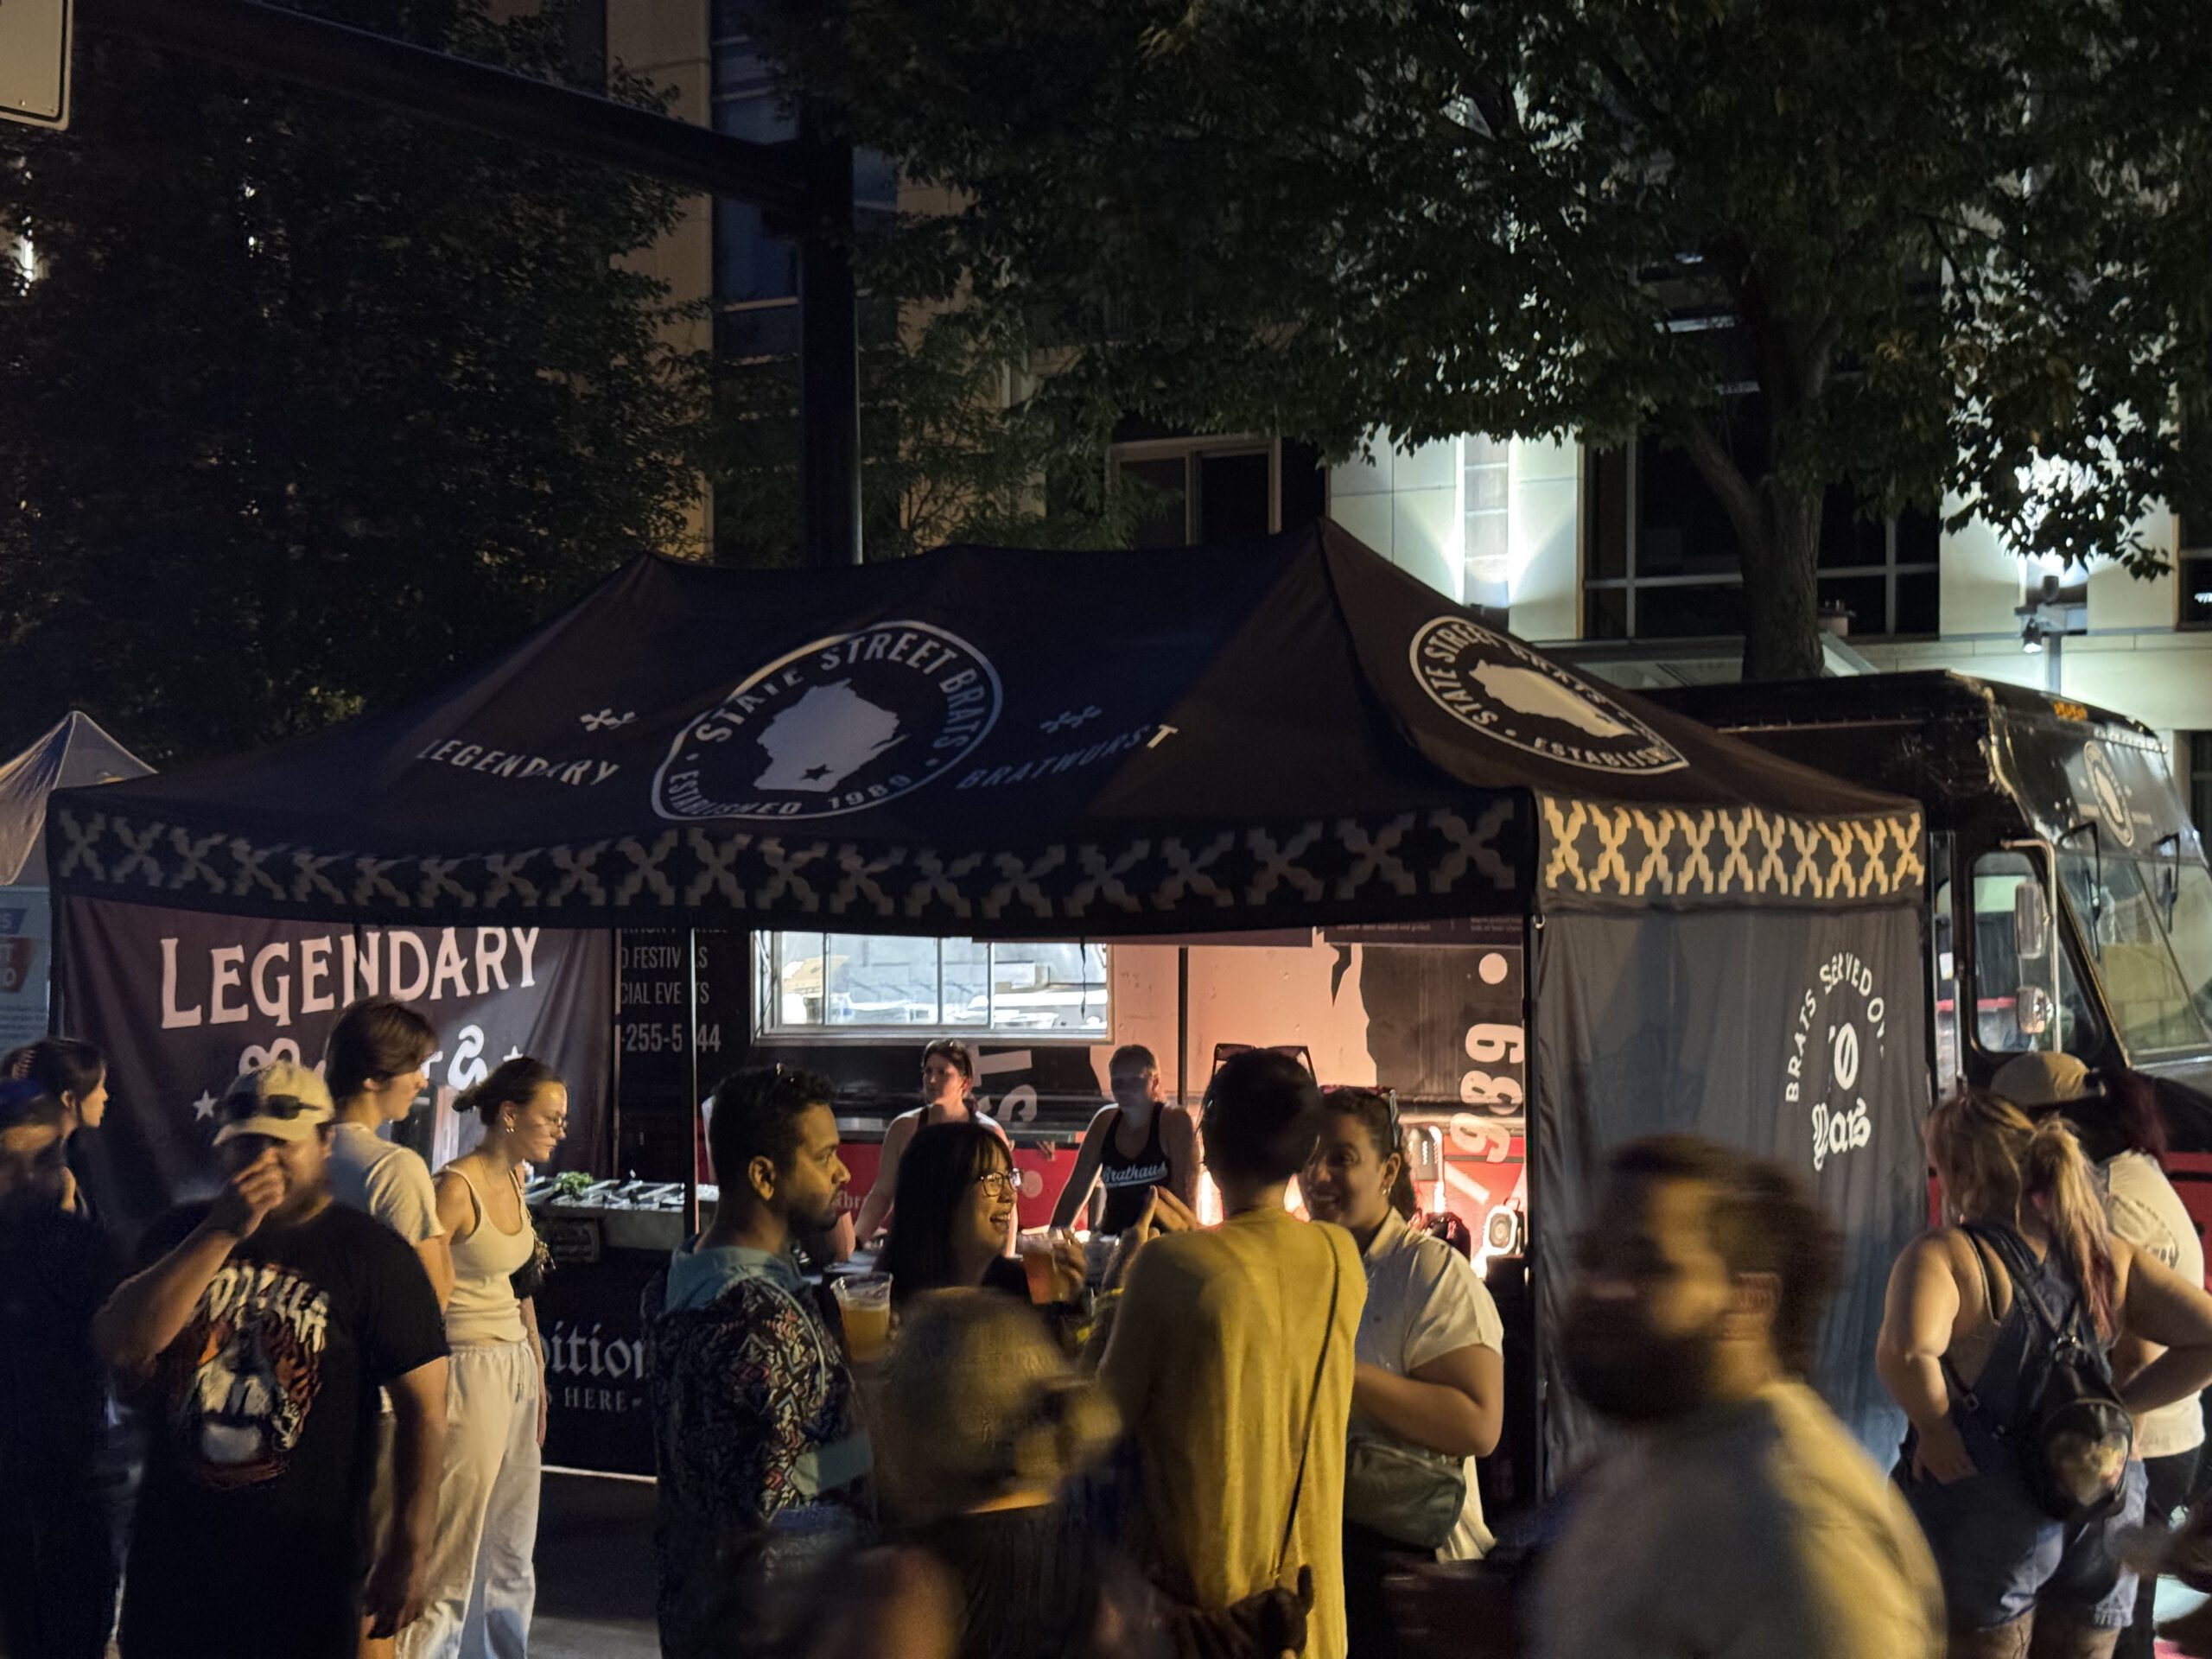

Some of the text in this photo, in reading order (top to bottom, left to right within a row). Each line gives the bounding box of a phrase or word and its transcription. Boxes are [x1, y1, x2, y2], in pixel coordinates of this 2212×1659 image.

[695, 632, 987, 750] STATE STREET BRATS
[1426, 665, 1499, 726] STATE
[416, 737, 621, 787] LEGENDARY
[161, 926, 541, 1029] LEGENDARY
[1785, 950, 1873, 1103] BRATS SERVED
